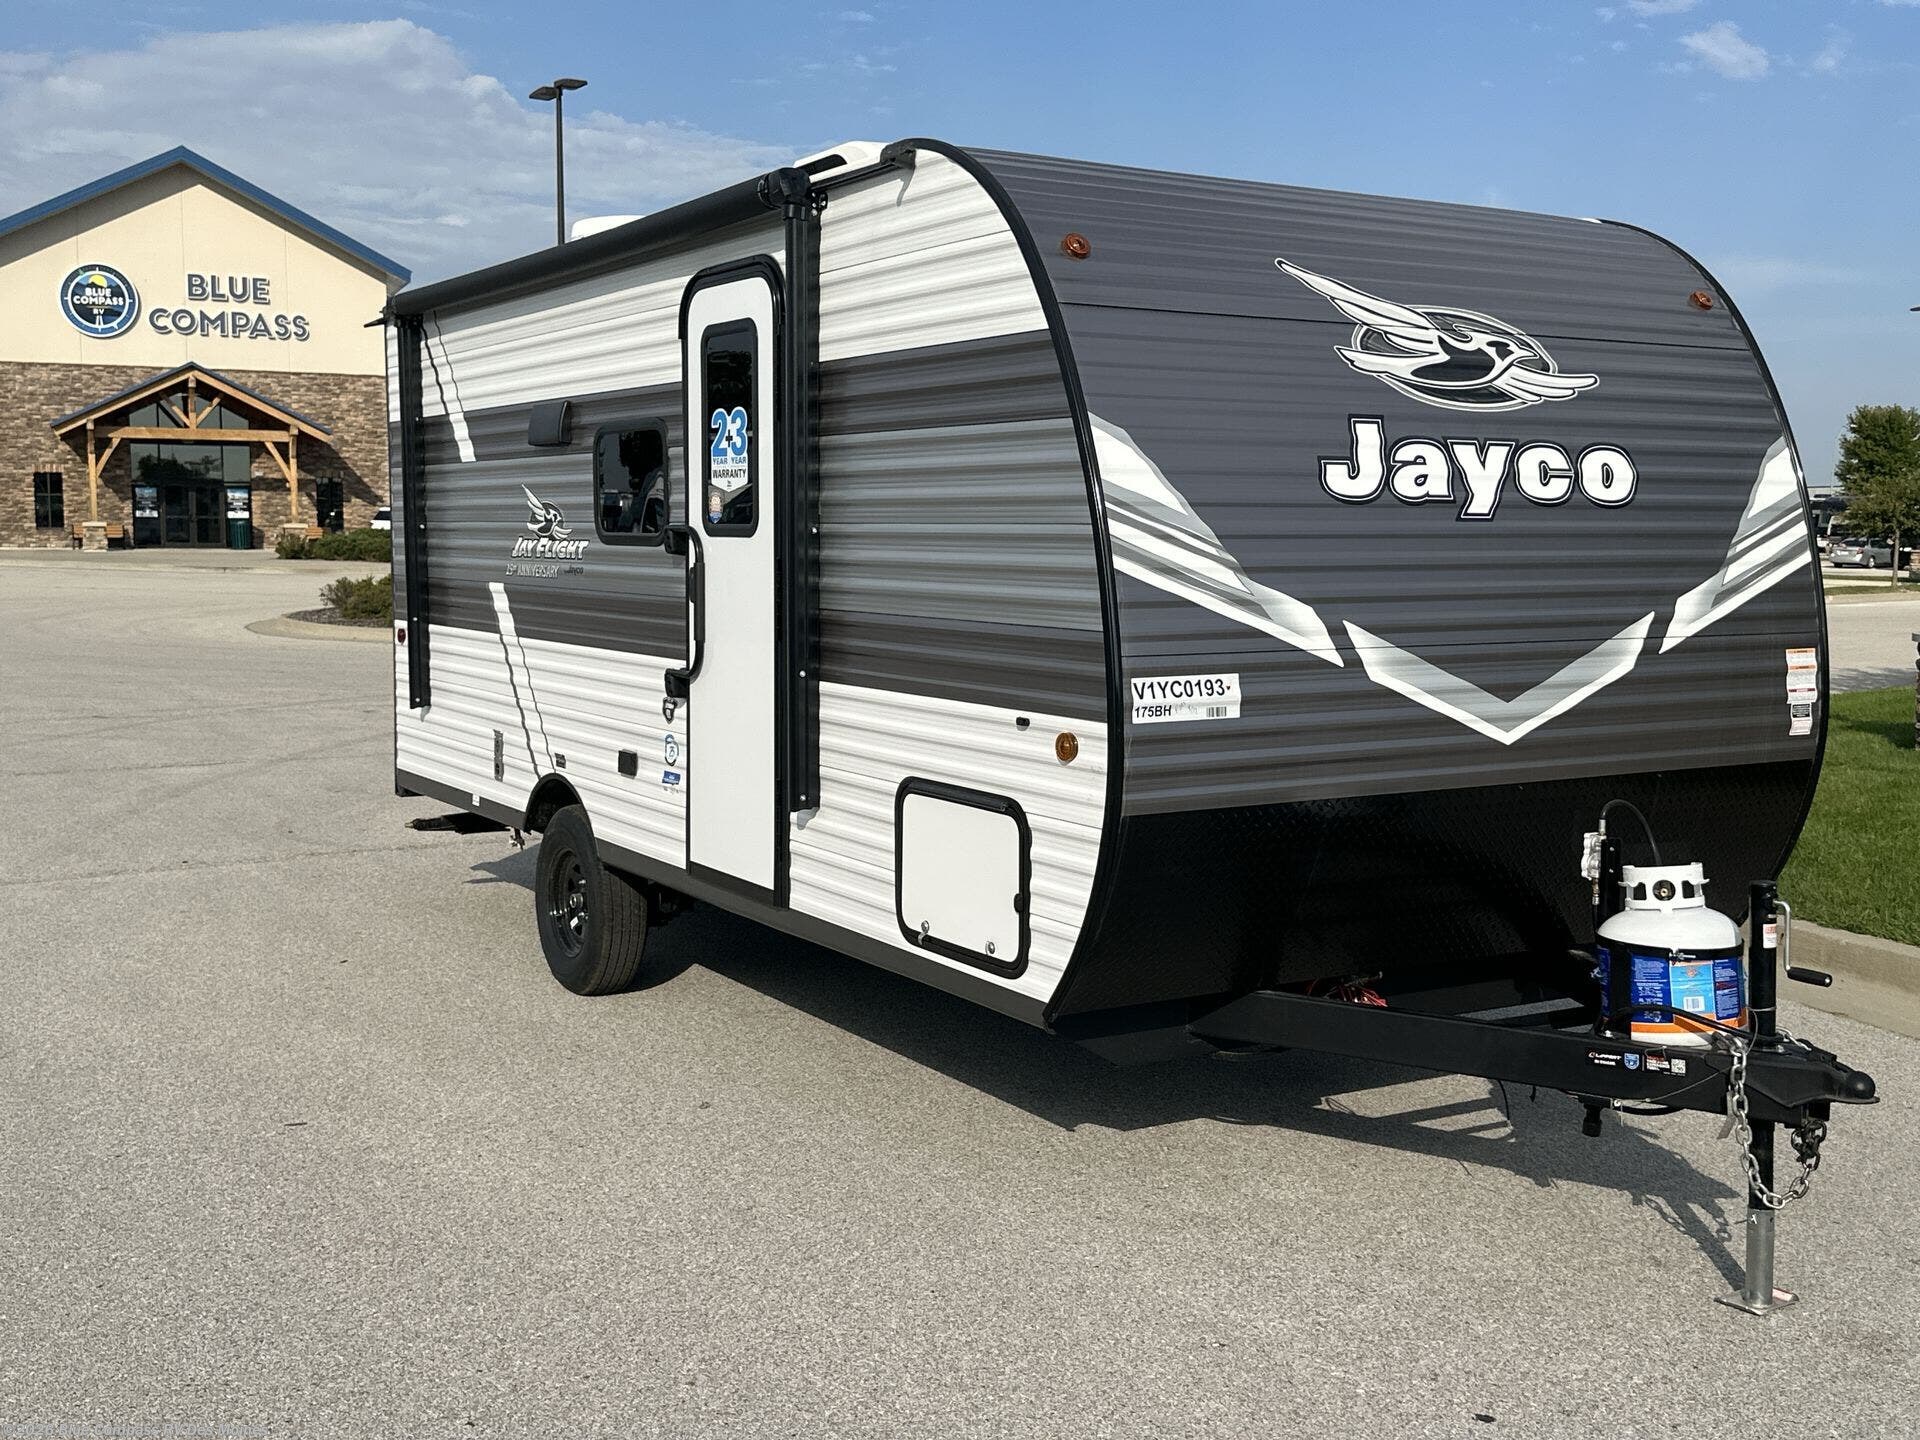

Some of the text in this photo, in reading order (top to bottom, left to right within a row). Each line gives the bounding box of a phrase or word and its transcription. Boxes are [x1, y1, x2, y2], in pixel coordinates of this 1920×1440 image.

[85, 287, 112, 297] BLUE
[187, 273, 271, 305] BLUE
[73, 295, 124, 306] COMPASS
[148, 307, 311, 342] COMPASS
[712, 456, 747, 465] YEAR YEAR
[1318, 415, 1638, 521] Jayco
[712, 468, 747, 479] WARRANTY
[511, 536, 590, 560] JAY FLIGHT
[517, 563, 560, 578] ANNIVERSARY
[1133, 678, 1226, 700] V1YC0193
[1134, 705, 1172, 718] 175BH
